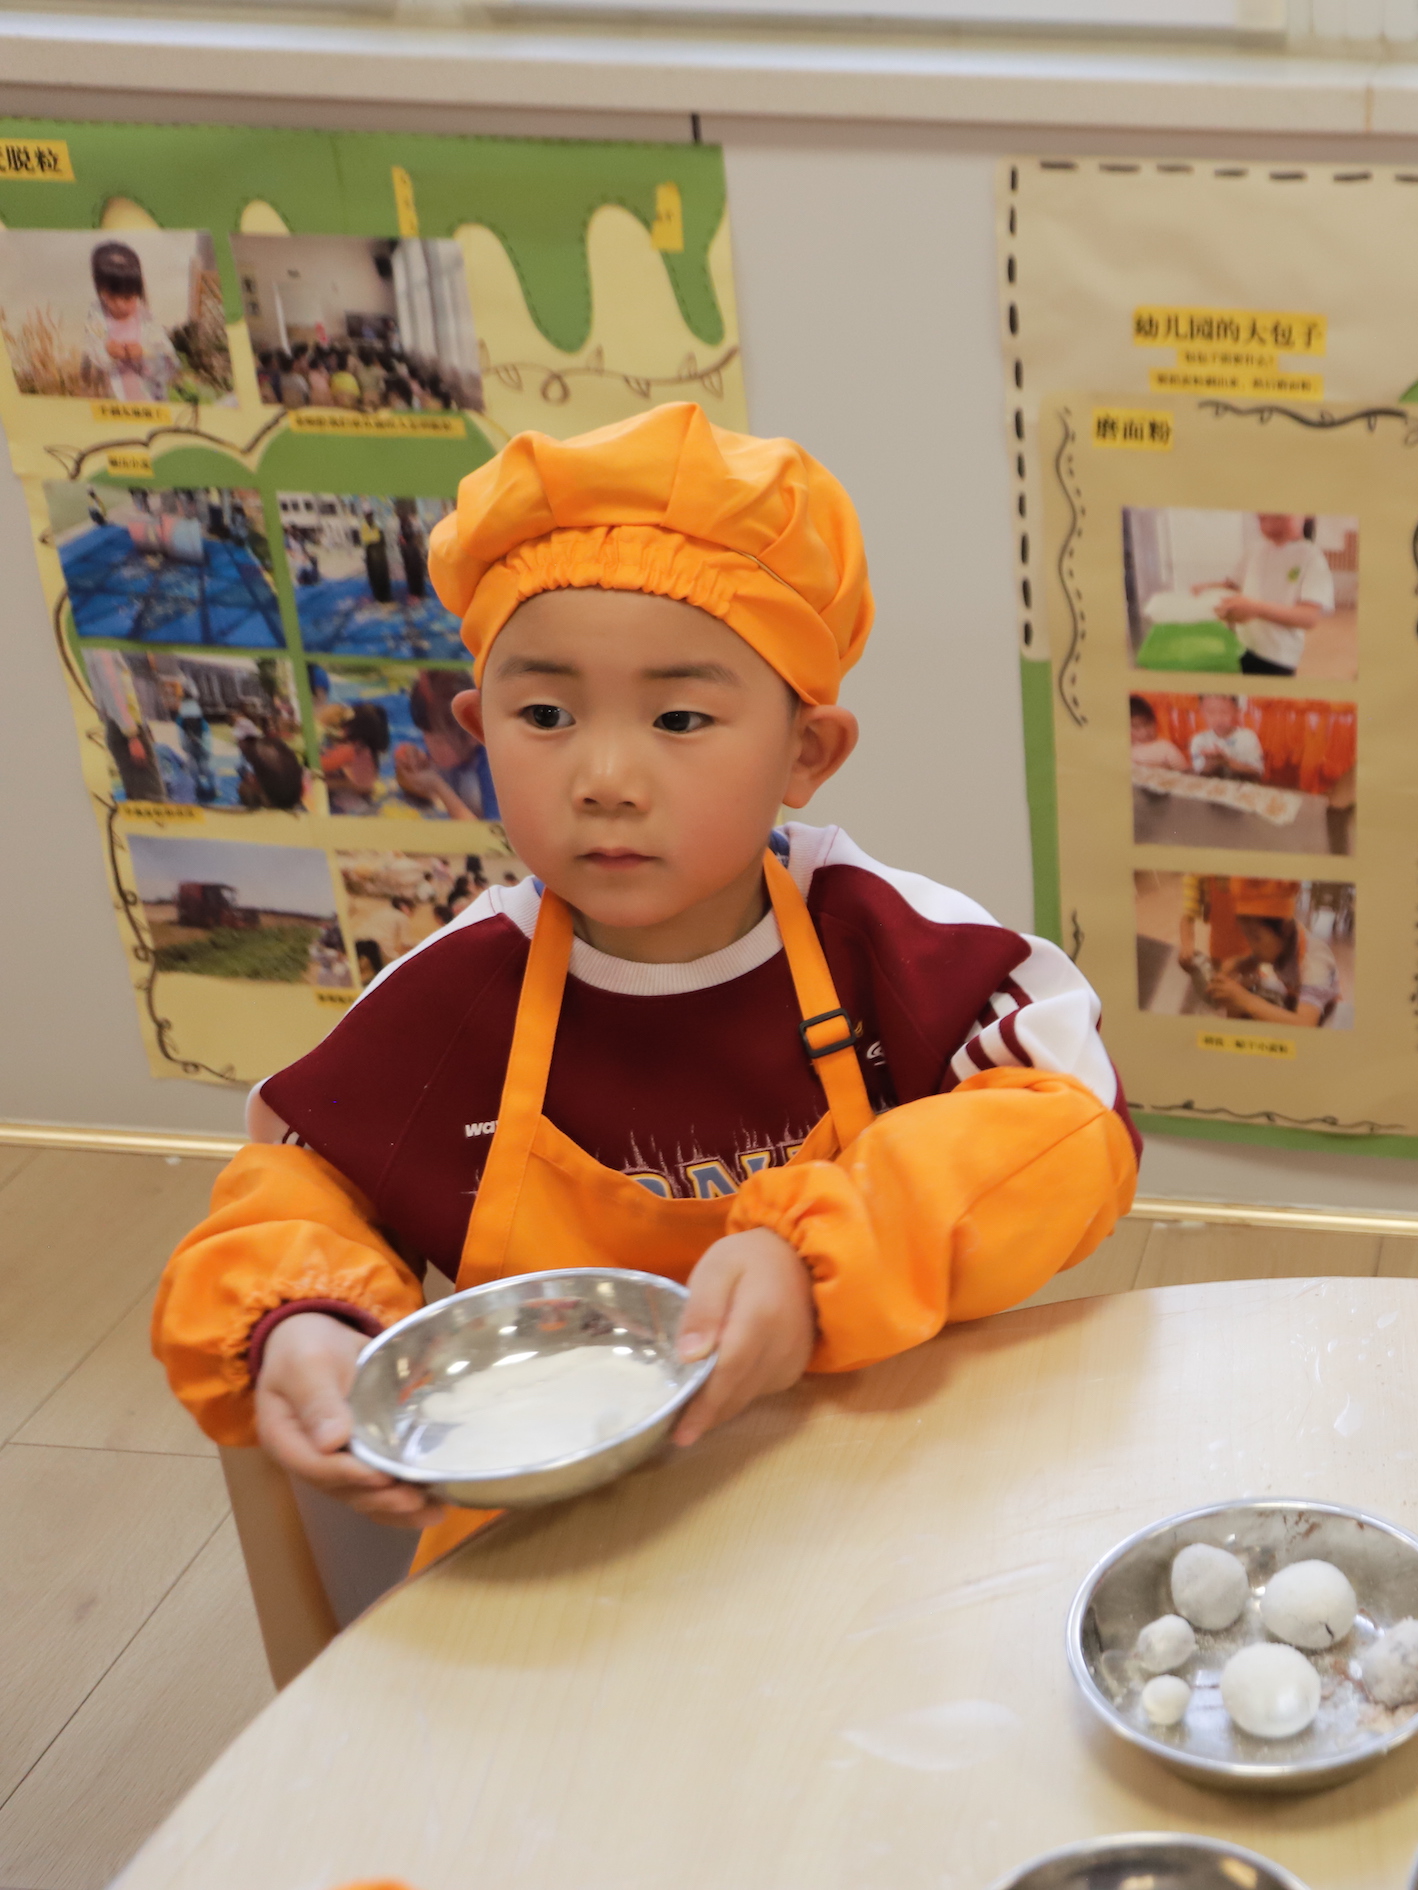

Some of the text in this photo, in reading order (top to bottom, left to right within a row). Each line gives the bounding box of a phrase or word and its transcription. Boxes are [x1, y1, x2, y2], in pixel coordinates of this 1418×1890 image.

[0, 145, 62, 173] 脱粒
[1134, 313, 1322, 349] 幼儿园的大包子
[1095, 413, 1171, 446] 磨面粉
[465, 1120, 498, 1138] wa
